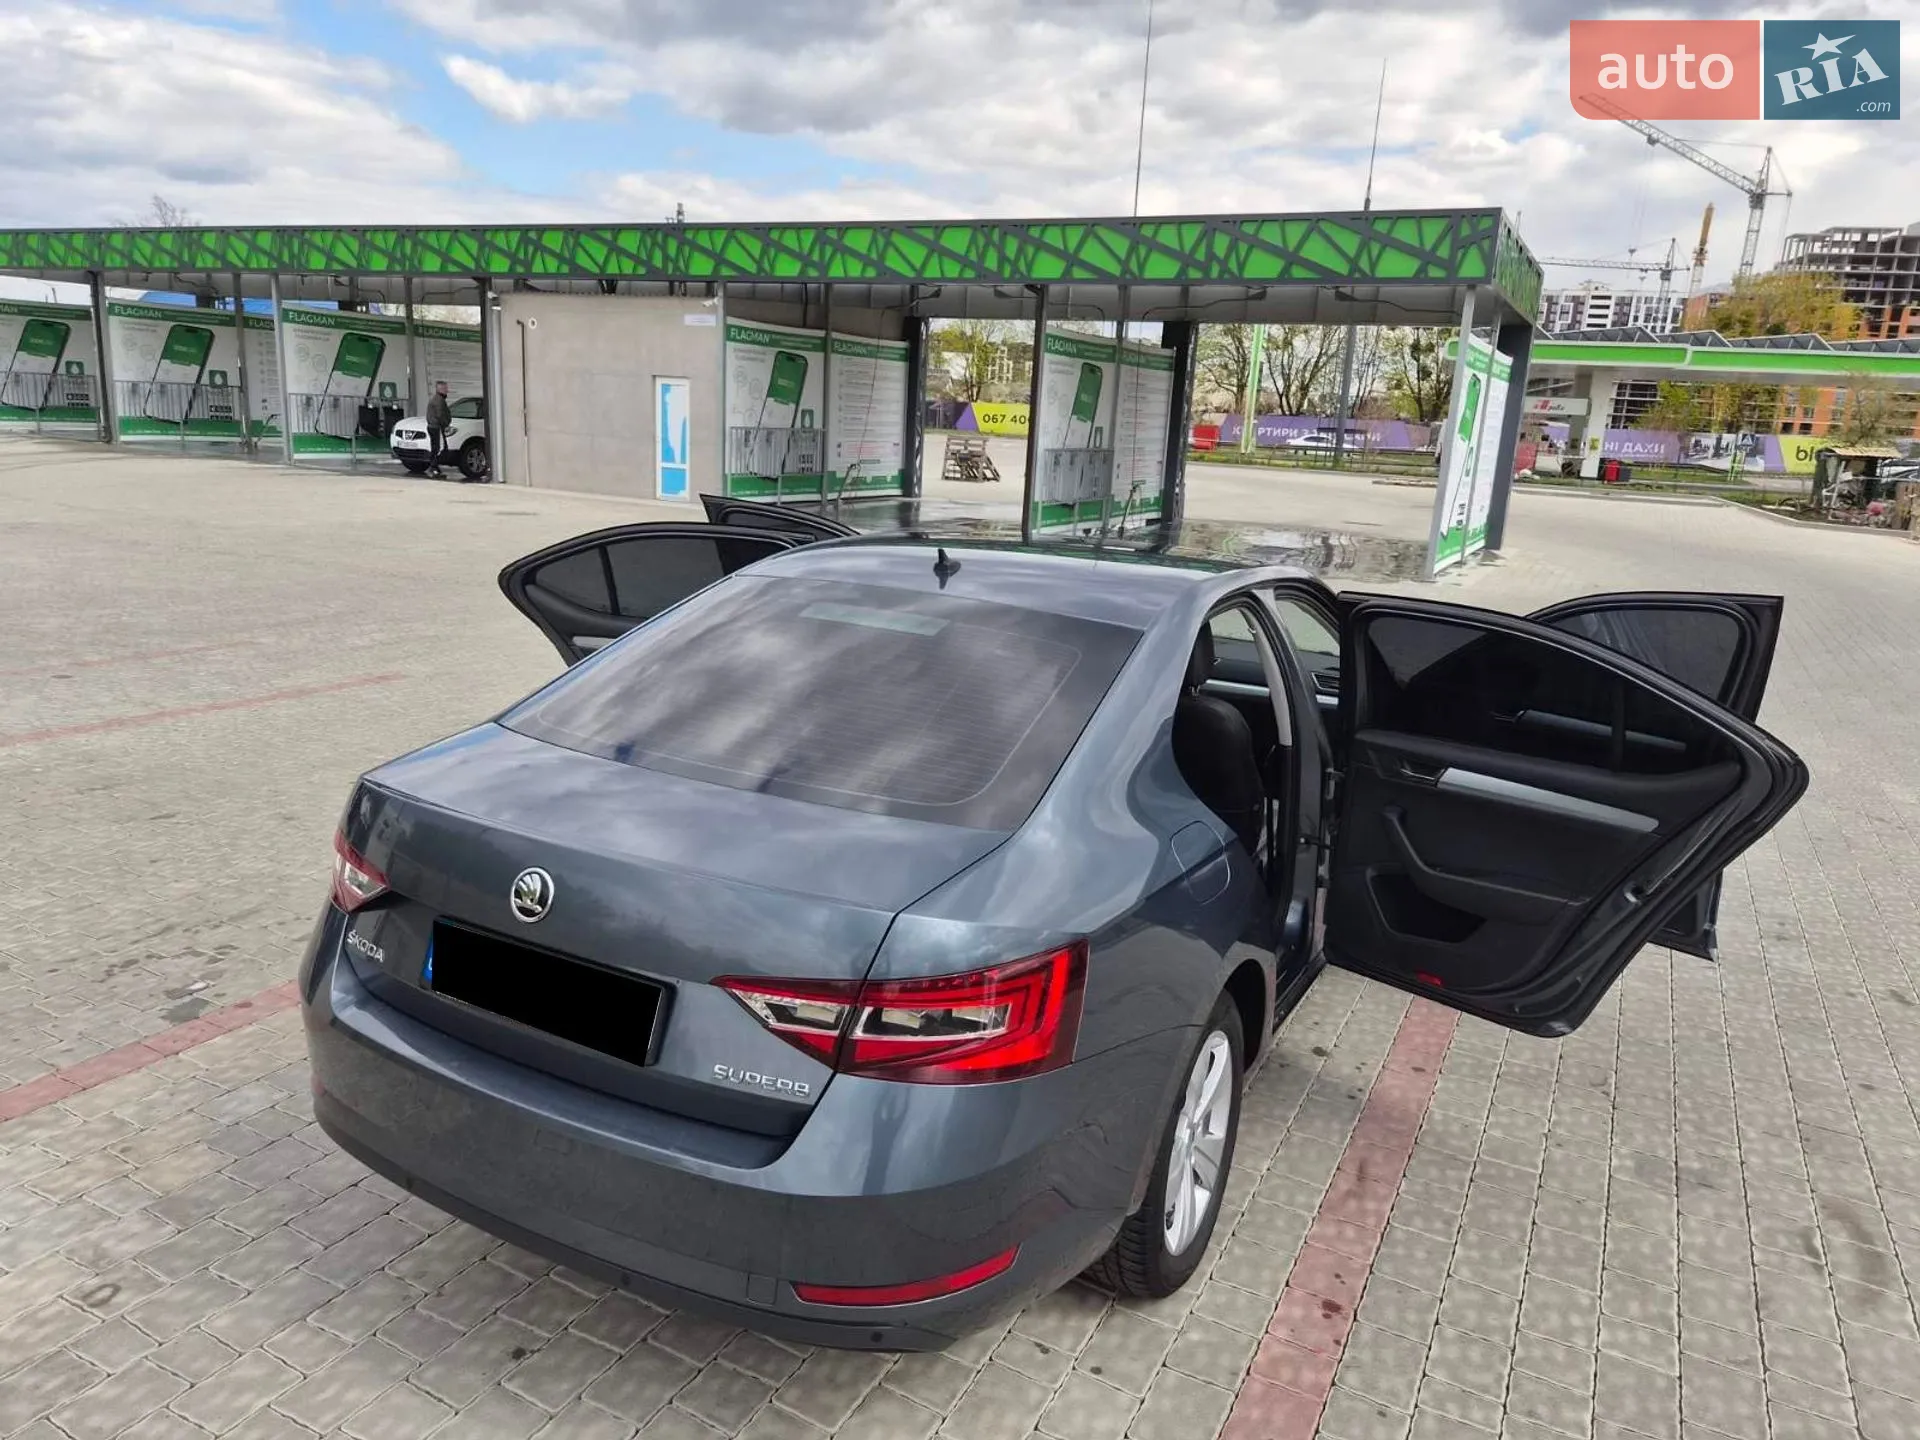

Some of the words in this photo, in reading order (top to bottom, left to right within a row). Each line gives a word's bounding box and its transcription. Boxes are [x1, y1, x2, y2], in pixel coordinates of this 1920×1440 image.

[288, 312, 336, 326] FLAGMAN
[730, 328, 771, 343] FLAGMAN
[982, 413, 1006, 423] 067
[1232, 425, 1299, 439] КРТИРИ
[1621, 441, 1665, 454] ДАХИ
[713, 1064, 810, 1097] SUPERB
